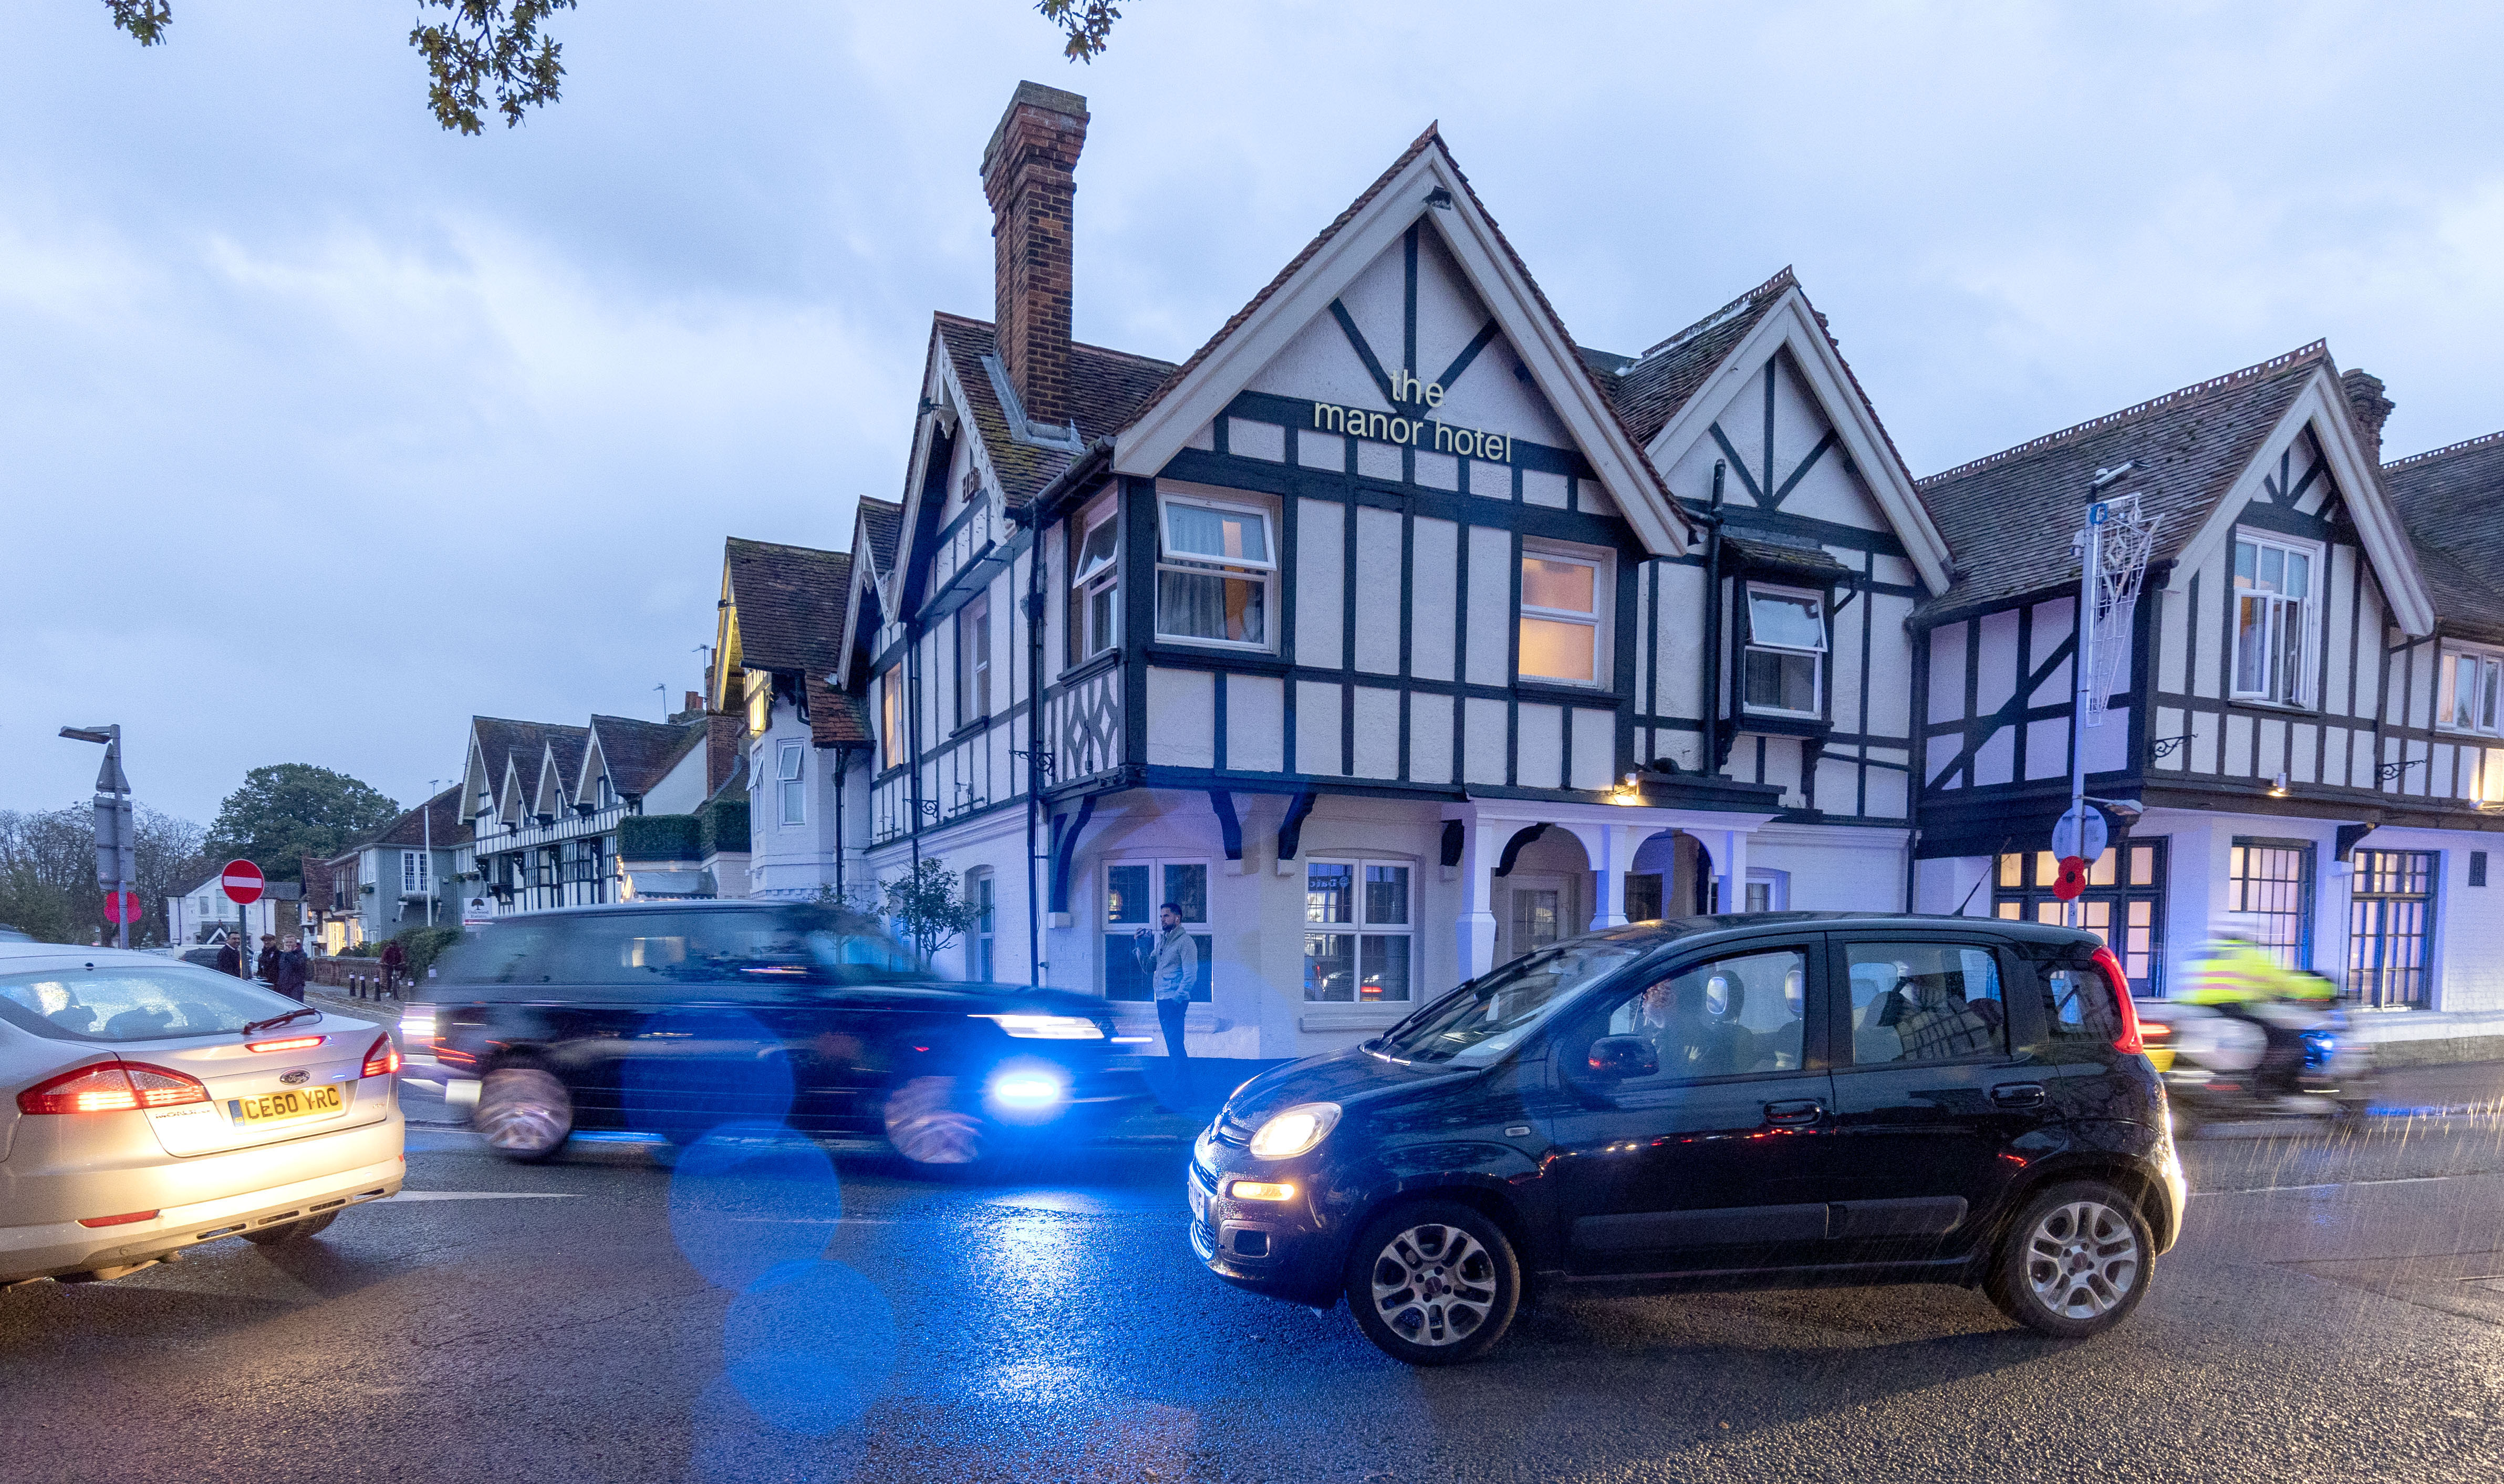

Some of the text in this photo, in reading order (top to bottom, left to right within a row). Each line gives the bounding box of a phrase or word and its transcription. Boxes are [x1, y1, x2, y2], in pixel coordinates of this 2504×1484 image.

[1390, 369, 1444, 408] the
[1314, 402, 1511, 462] manor hotel
[245, 1087, 339, 1119] CE60 YRC
